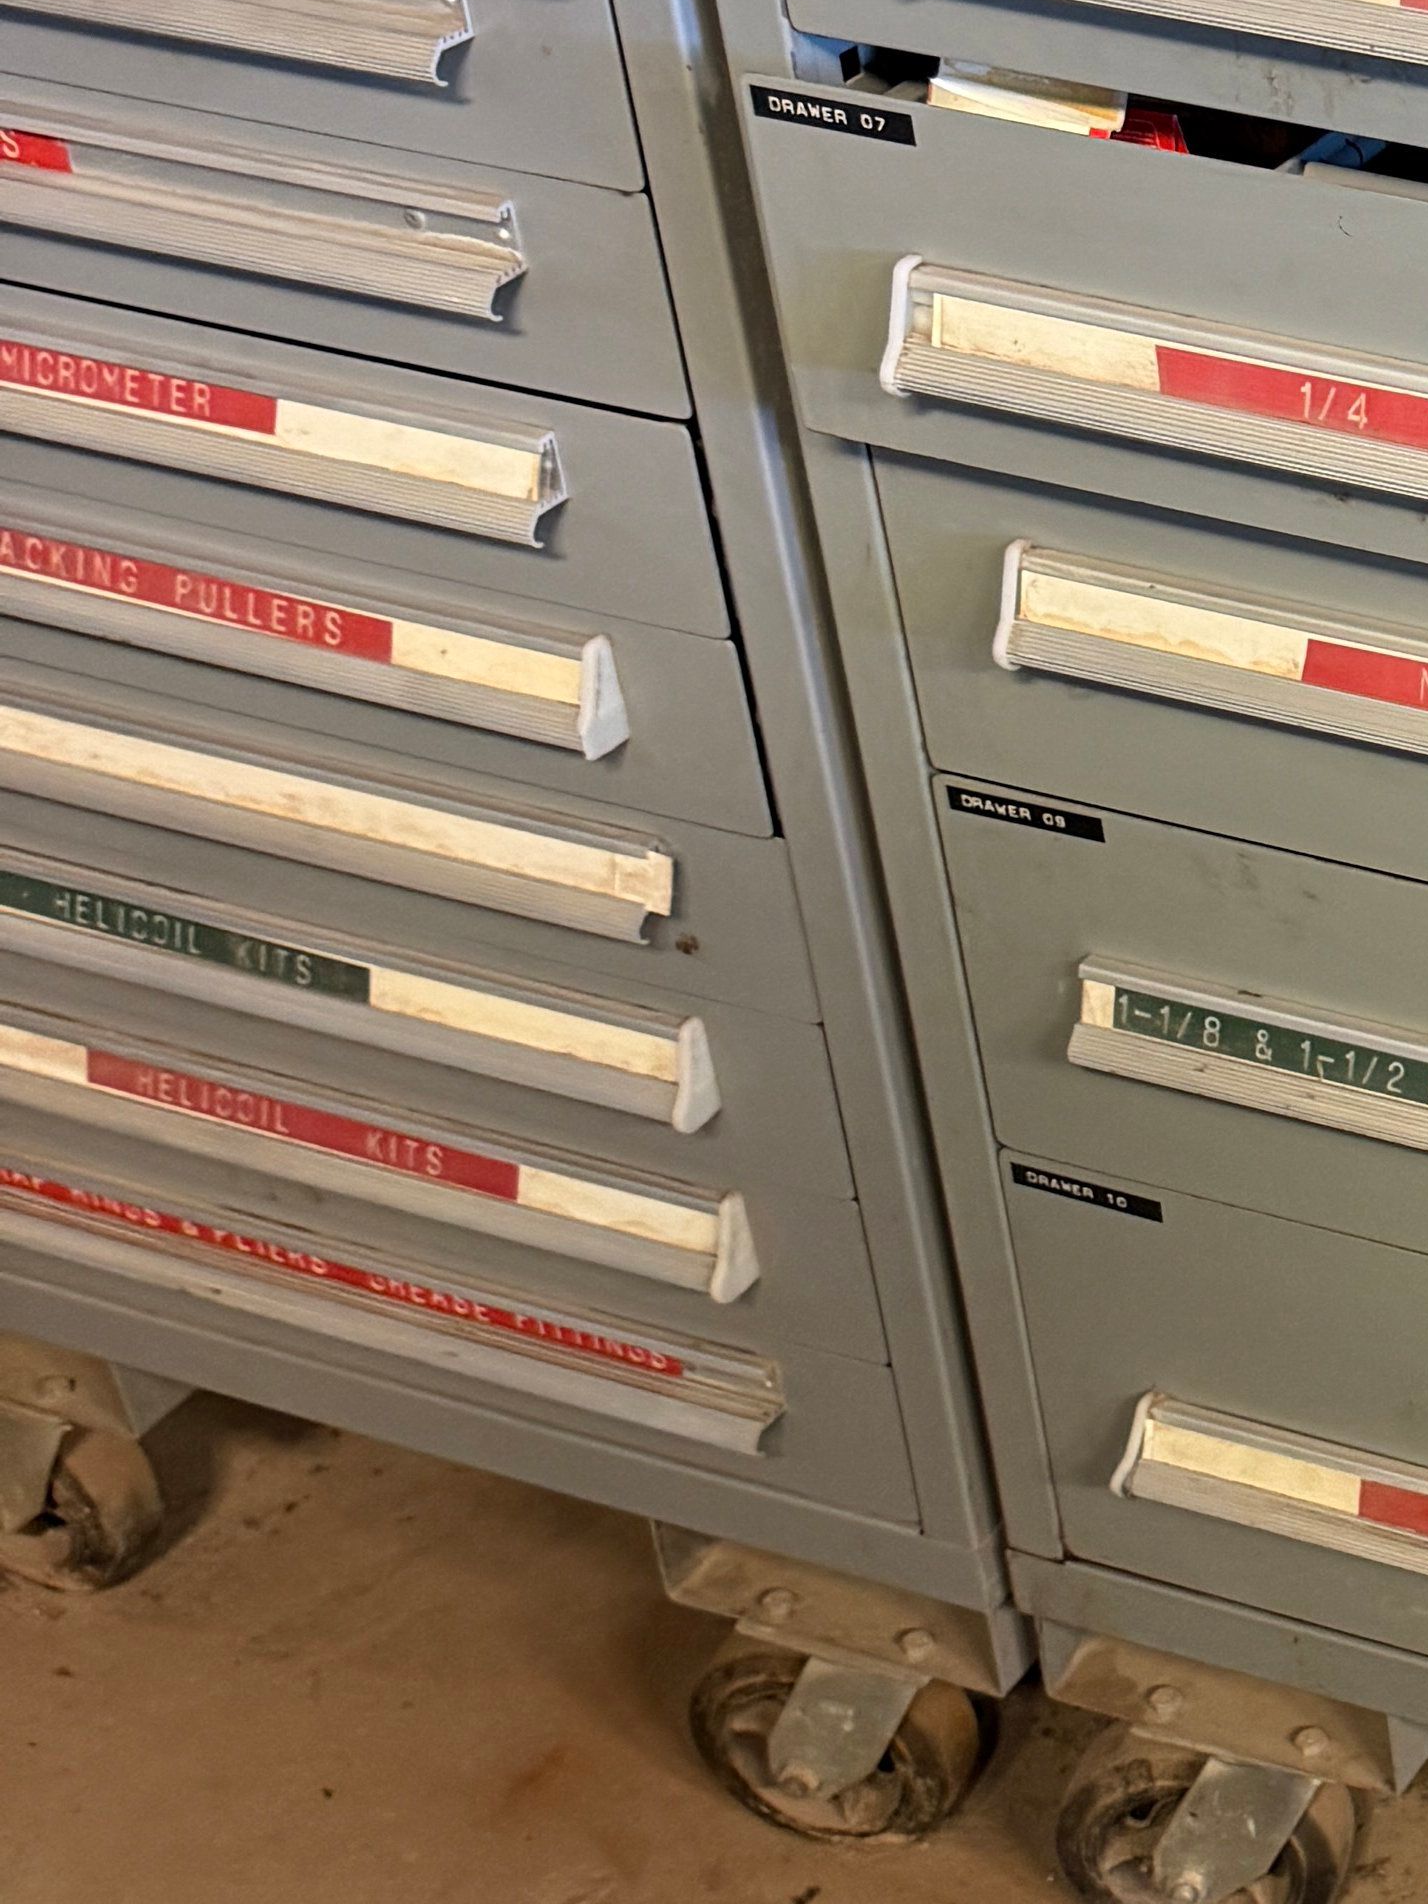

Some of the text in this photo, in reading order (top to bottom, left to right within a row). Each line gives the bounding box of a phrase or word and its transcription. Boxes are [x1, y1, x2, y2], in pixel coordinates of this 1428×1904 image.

[768, 96, 886, 133] DRAWER 07
[0, 345, 211, 418] MICROMETER
[1300, 381, 1369, 431] 1/4
[174, 573, 344, 648] PULLERS
[960, 794, 1032, 822] DRAWER
[233, 941, 313, 986] KITS
[1115, 994, 1222, 1050] 1-1/8
[1254, 1028, 1273, 1062] &
[1300, 1039, 1406, 1094] 1-1/2
[137, 1073, 445, 1177] HELICOIL KITS
[1025, 1170, 1128, 1209] DRAWER 10
